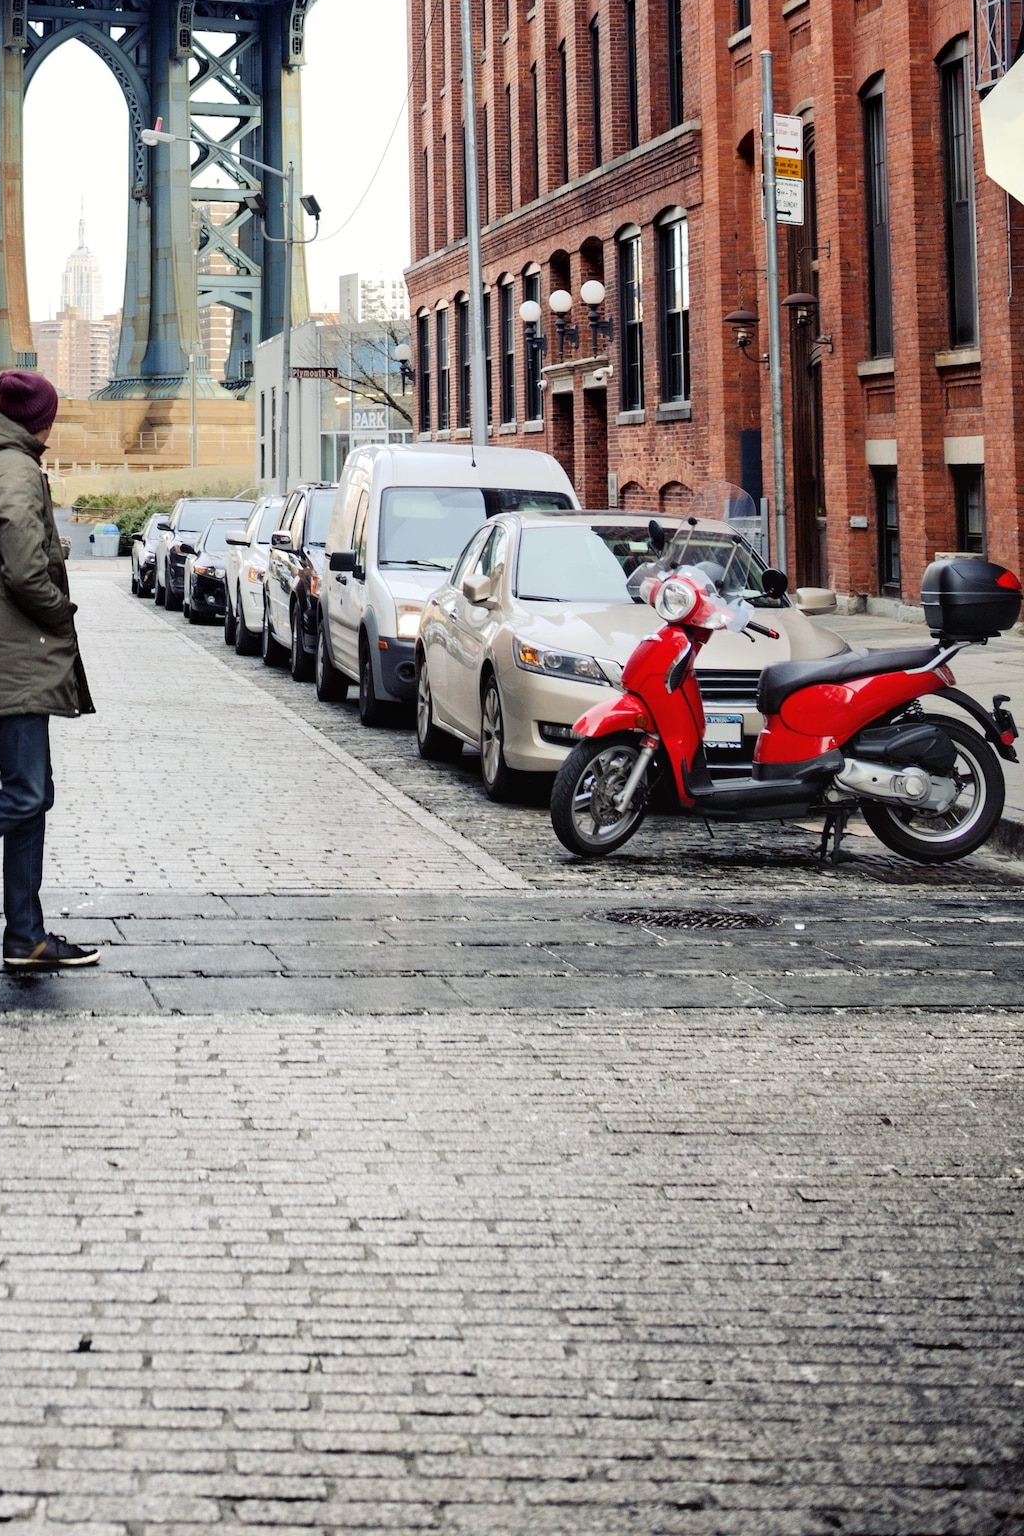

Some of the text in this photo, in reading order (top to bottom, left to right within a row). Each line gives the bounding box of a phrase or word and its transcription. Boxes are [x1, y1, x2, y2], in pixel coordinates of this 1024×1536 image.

[293, 368, 335, 378] Plymouth St
[354, 411, 385, 426] PARK
